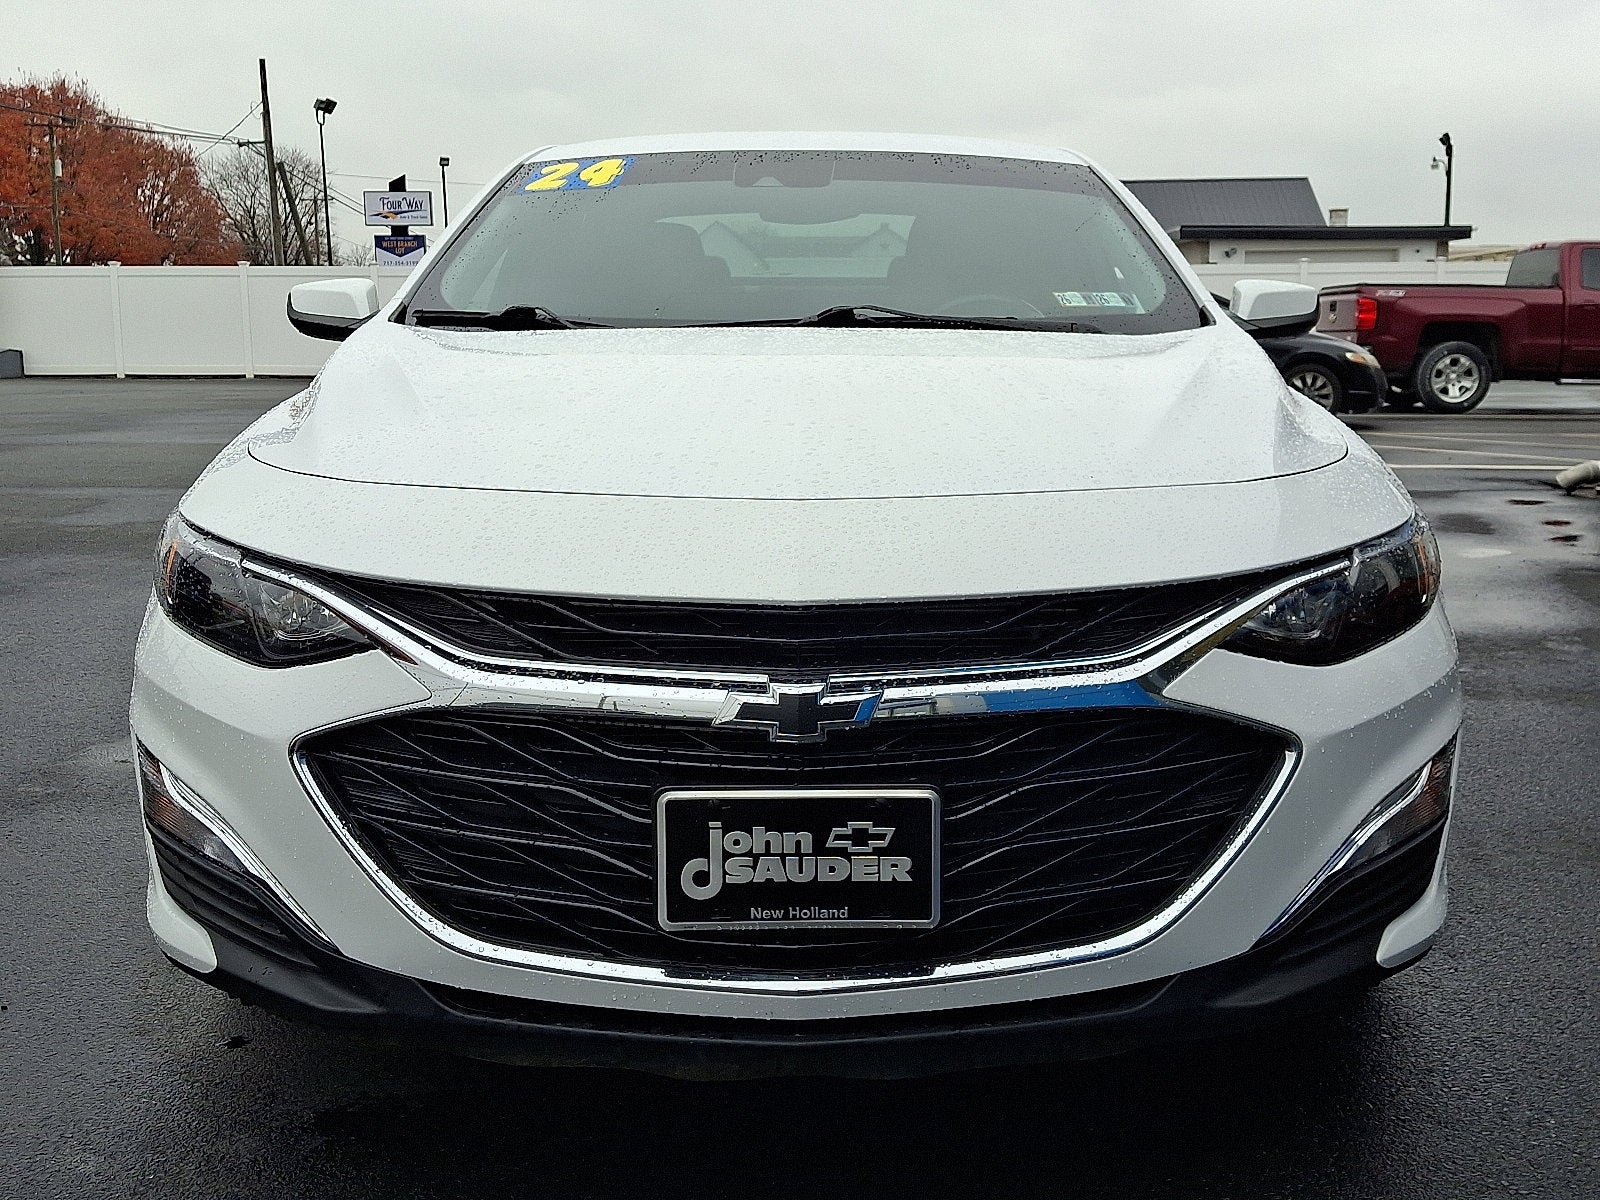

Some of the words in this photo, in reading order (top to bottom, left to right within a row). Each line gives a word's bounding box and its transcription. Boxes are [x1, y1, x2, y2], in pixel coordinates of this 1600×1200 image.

[524, 158, 627, 192] 24
[680, 821, 813, 901] john
[725, 856, 913, 884] SAUDER
[750, 907, 784, 920] New
[789, 906, 849, 920] Holland
